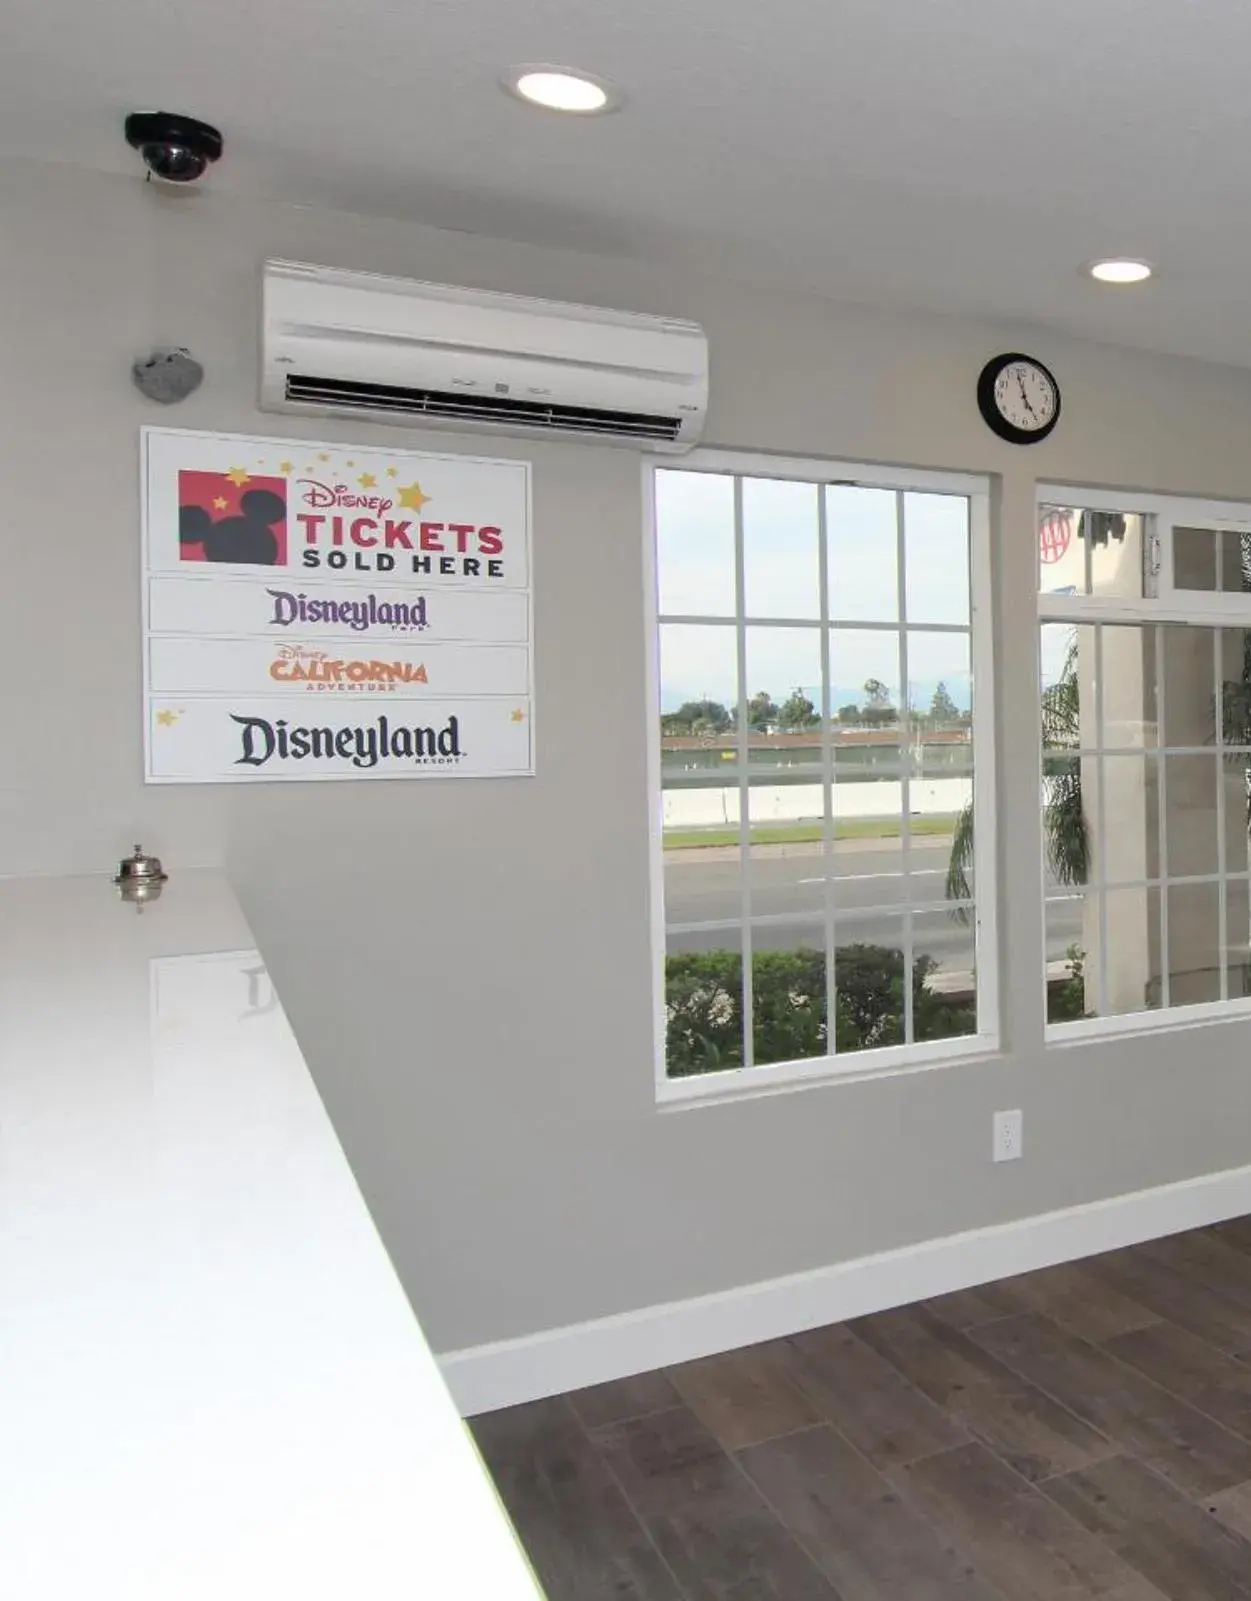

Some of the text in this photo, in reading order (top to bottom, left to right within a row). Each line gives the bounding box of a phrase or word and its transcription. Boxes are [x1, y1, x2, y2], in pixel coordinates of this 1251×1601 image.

[296, 513, 504, 554] TICKETS
[302, 549, 504, 578] SOLD HERE
[265, 587, 428, 632] Disneyland
[269, 659, 428, 685] CALIFORNIA
[229, 713, 461, 768] Disneyland
